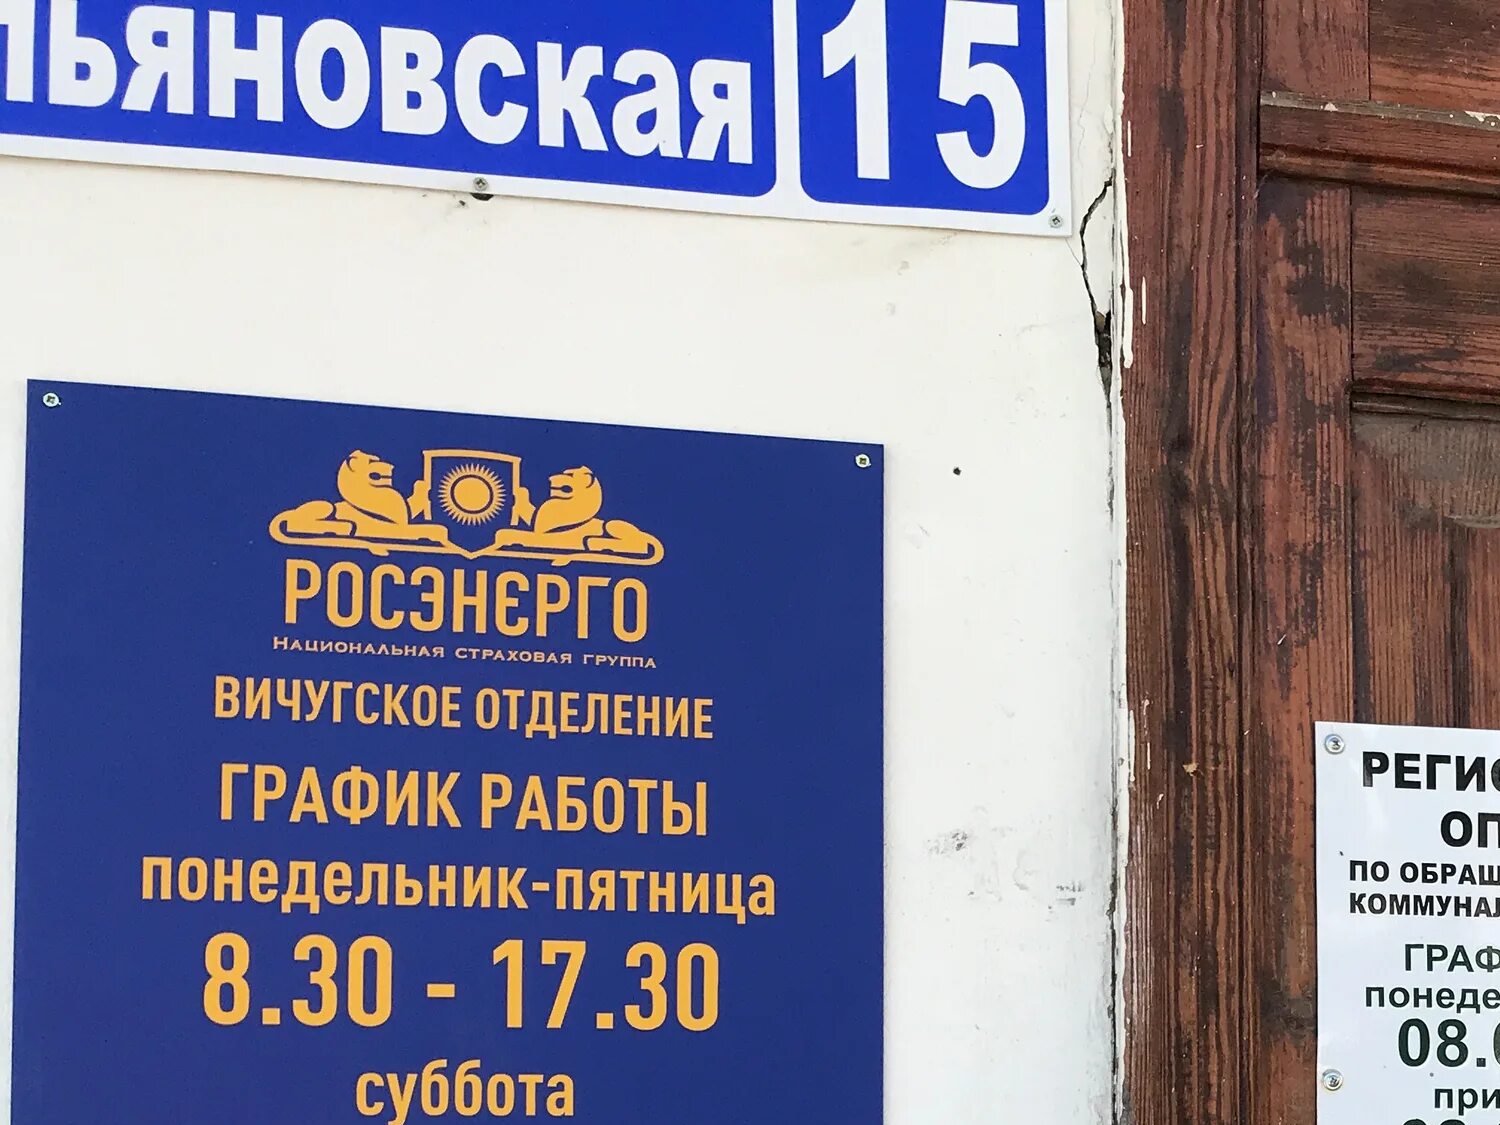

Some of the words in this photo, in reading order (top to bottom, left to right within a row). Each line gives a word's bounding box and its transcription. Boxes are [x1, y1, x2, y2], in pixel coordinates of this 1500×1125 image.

[822, 0, 1026, 189] 15
[215, 676, 461, 727] ВИЧУГСКОЕ
[476, 688, 712, 739] ОТДЕЛЕНИЕ
[221, 763, 461, 827] ГРАФИК
[482, 773, 706, 835] РАБОТЫ
[143, 857, 774, 924] понедельник-пятница
[1350, 860, 1389, 882] ПО
[204, 933, 392, 1027] 8.30
[427, 984, 455, 997] -
[493, 940, 718, 1031] 17.30
